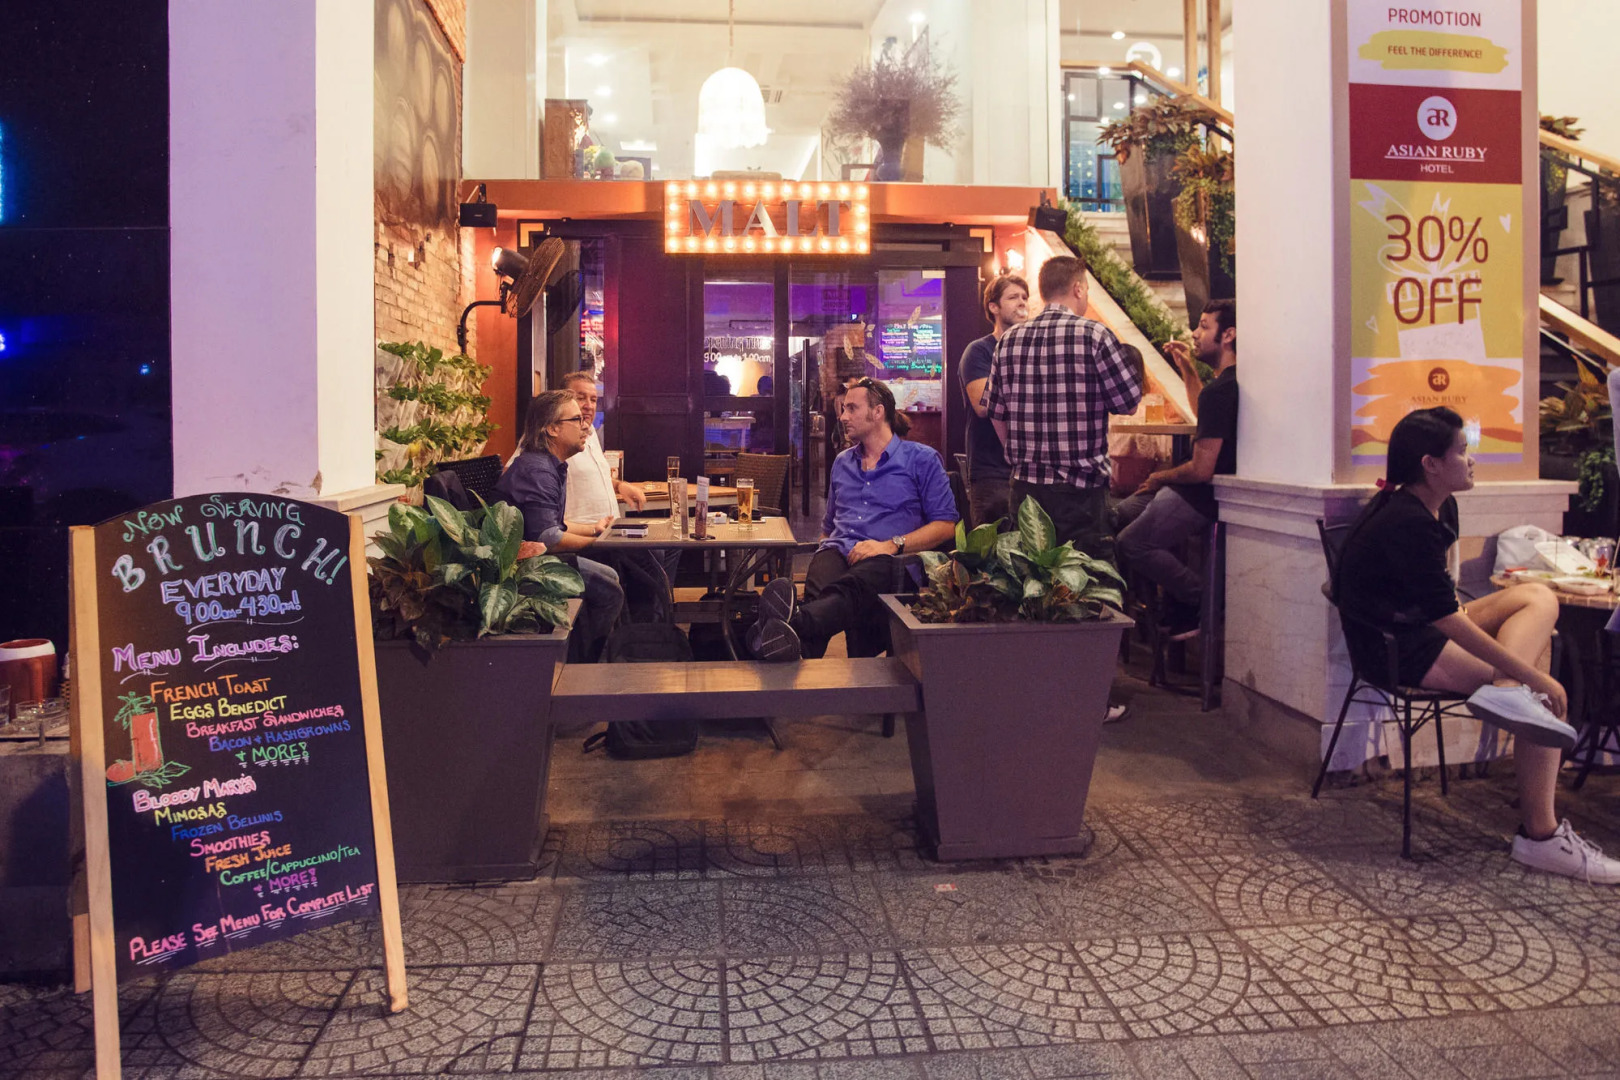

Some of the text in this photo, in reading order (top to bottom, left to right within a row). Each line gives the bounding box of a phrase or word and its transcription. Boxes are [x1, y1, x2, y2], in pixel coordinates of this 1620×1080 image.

[1388, 8, 1482, 27] PROMOTION
[1387, 45, 1482, 59] FEEL THE DIFFERENCE!
[1387, 145, 1487, 160] ASIAN RUBY
[1420, 164, 1454, 173] HOTEL
[685, 199, 850, 238] MALT
[1386, 214, 1489, 263] 30%
[1393, 277, 1482, 324] OFF
[201, 494, 305, 526] SERVING
[112, 518, 347, 593] BRUNCH!
[160, 567, 286, 604] EVERYDAY
[112, 634, 299, 672] MENU INCLUDES:
[150, 674, 271, 704] FRENCH TOAST
[170, 695, 287, 721] EGGS BENEDICT
[186, 704, 345, 738] BREAKFAST SANDWICHES
[209, 736, 252, 752] BACON
[264, 719, 351, 744] HASHBROWNS
[252, 742, 310, 762] MORE!
[132, 786, 200, 813] BLOODY
[154, 802, 228, 826] MIMOSAS
[171, 811, 283, 841] FROZEN BELLINIS
[190, 830, 271, 857] SMOOTHIES
[205, 844, 292, 873] FRESH JUICE
[269, 868, 317, 890] MORE!
[129, 883, 375, 961] PLEASE SEE MENU FOR COMPLETE LIST
